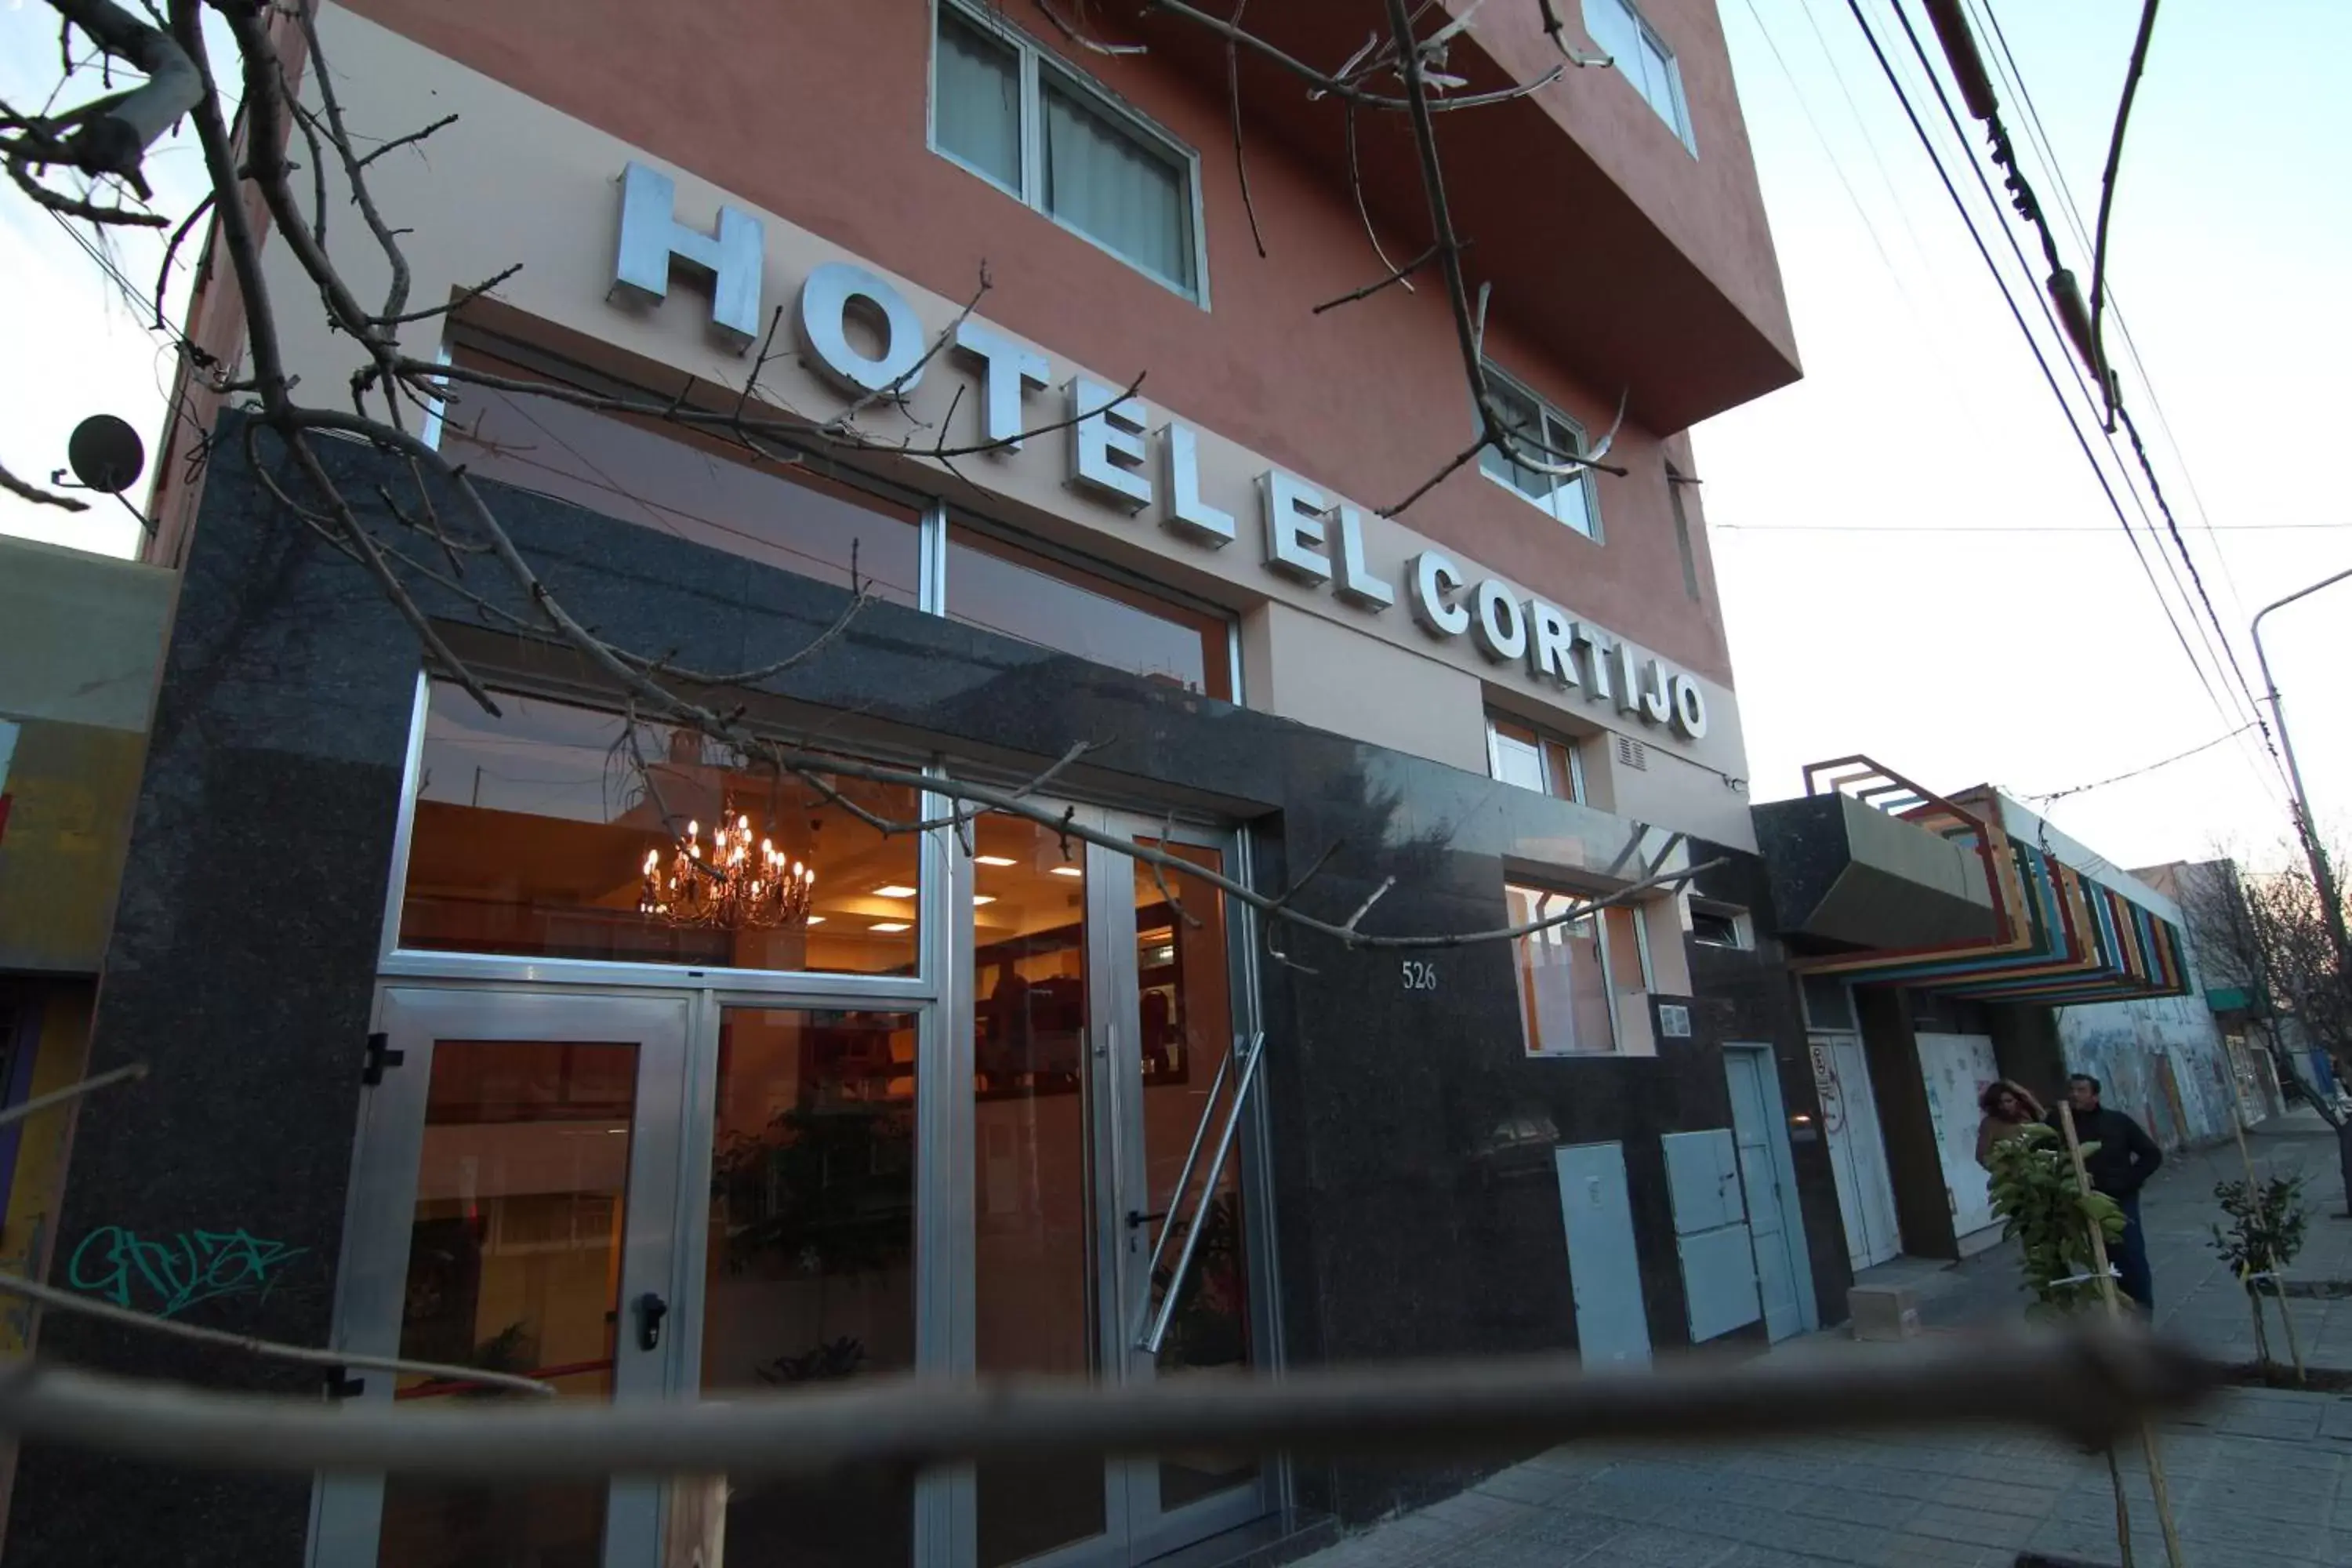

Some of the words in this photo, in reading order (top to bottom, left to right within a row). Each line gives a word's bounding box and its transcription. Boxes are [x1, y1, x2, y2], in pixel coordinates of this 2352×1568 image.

[616, 160, 1236, 548] HOTEL
[1263, 469, 1394, 612] EL
[1406, 550, 1708, 740] CORTIJO
[1403, 960, 1436, 990] 526
